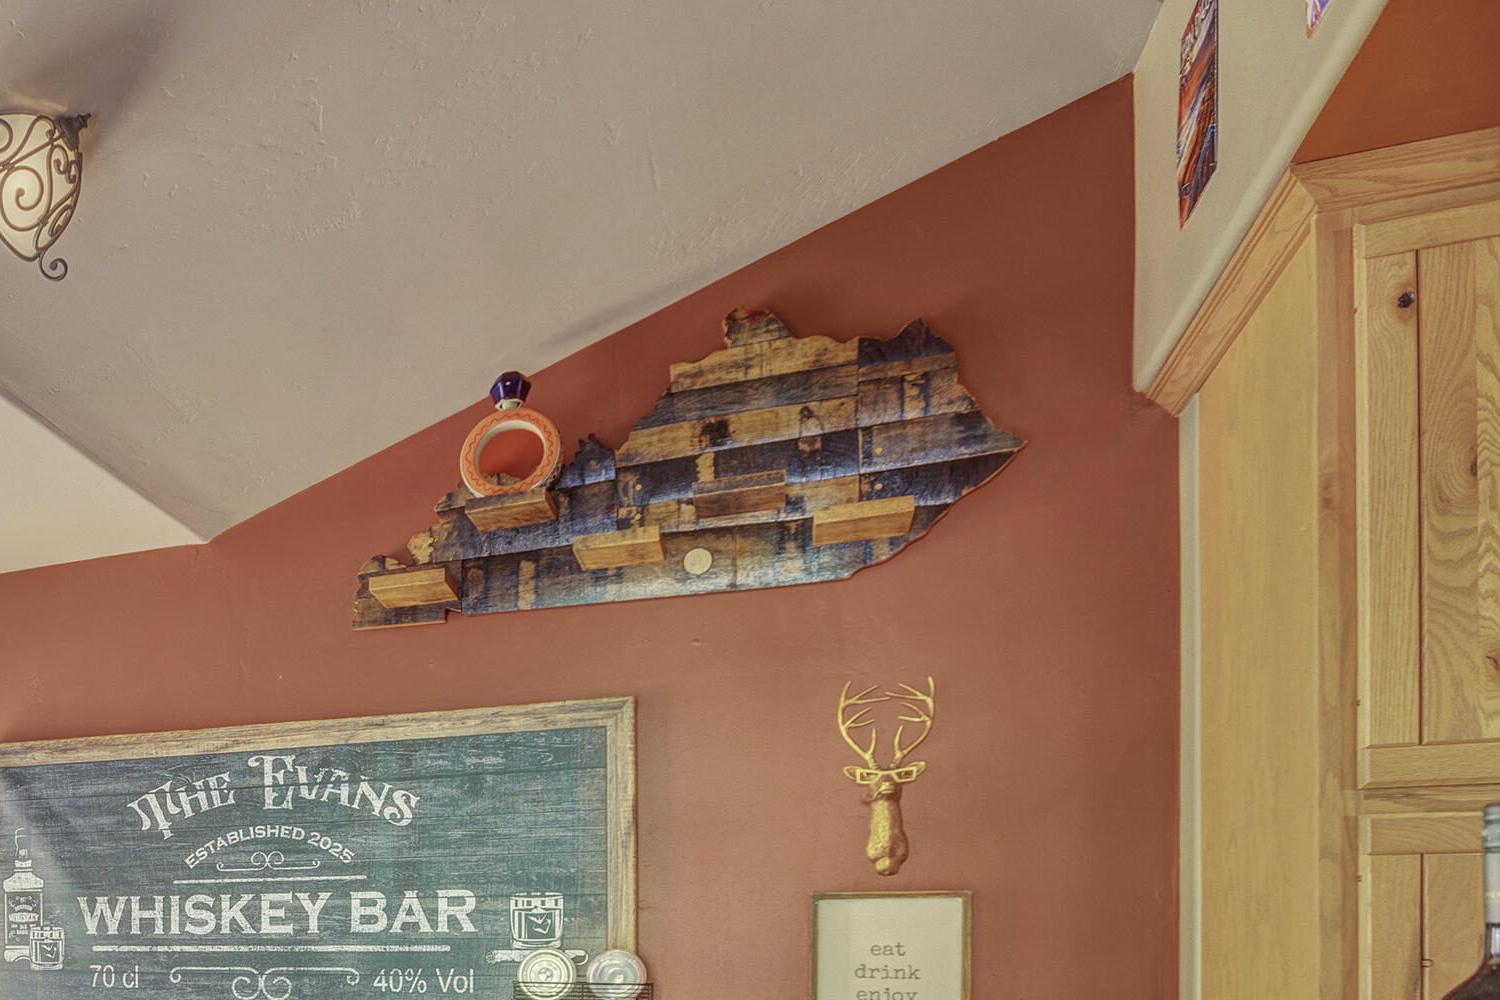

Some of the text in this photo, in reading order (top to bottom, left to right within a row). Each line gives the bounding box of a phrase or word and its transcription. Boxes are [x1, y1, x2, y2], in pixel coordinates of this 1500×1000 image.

[127, 754, 421, 840] THE EVANS
[184, 824, 355, 869] ESTABLISHED 2025
[76, 889, 479, 936] WHISKEY BAR
[870, 941, 906, 956] eat
[89, 964, 139, 989] 70 cl
[373, 967, 474, 994] 40% Vol
[854, 963, 921, 980] drink
